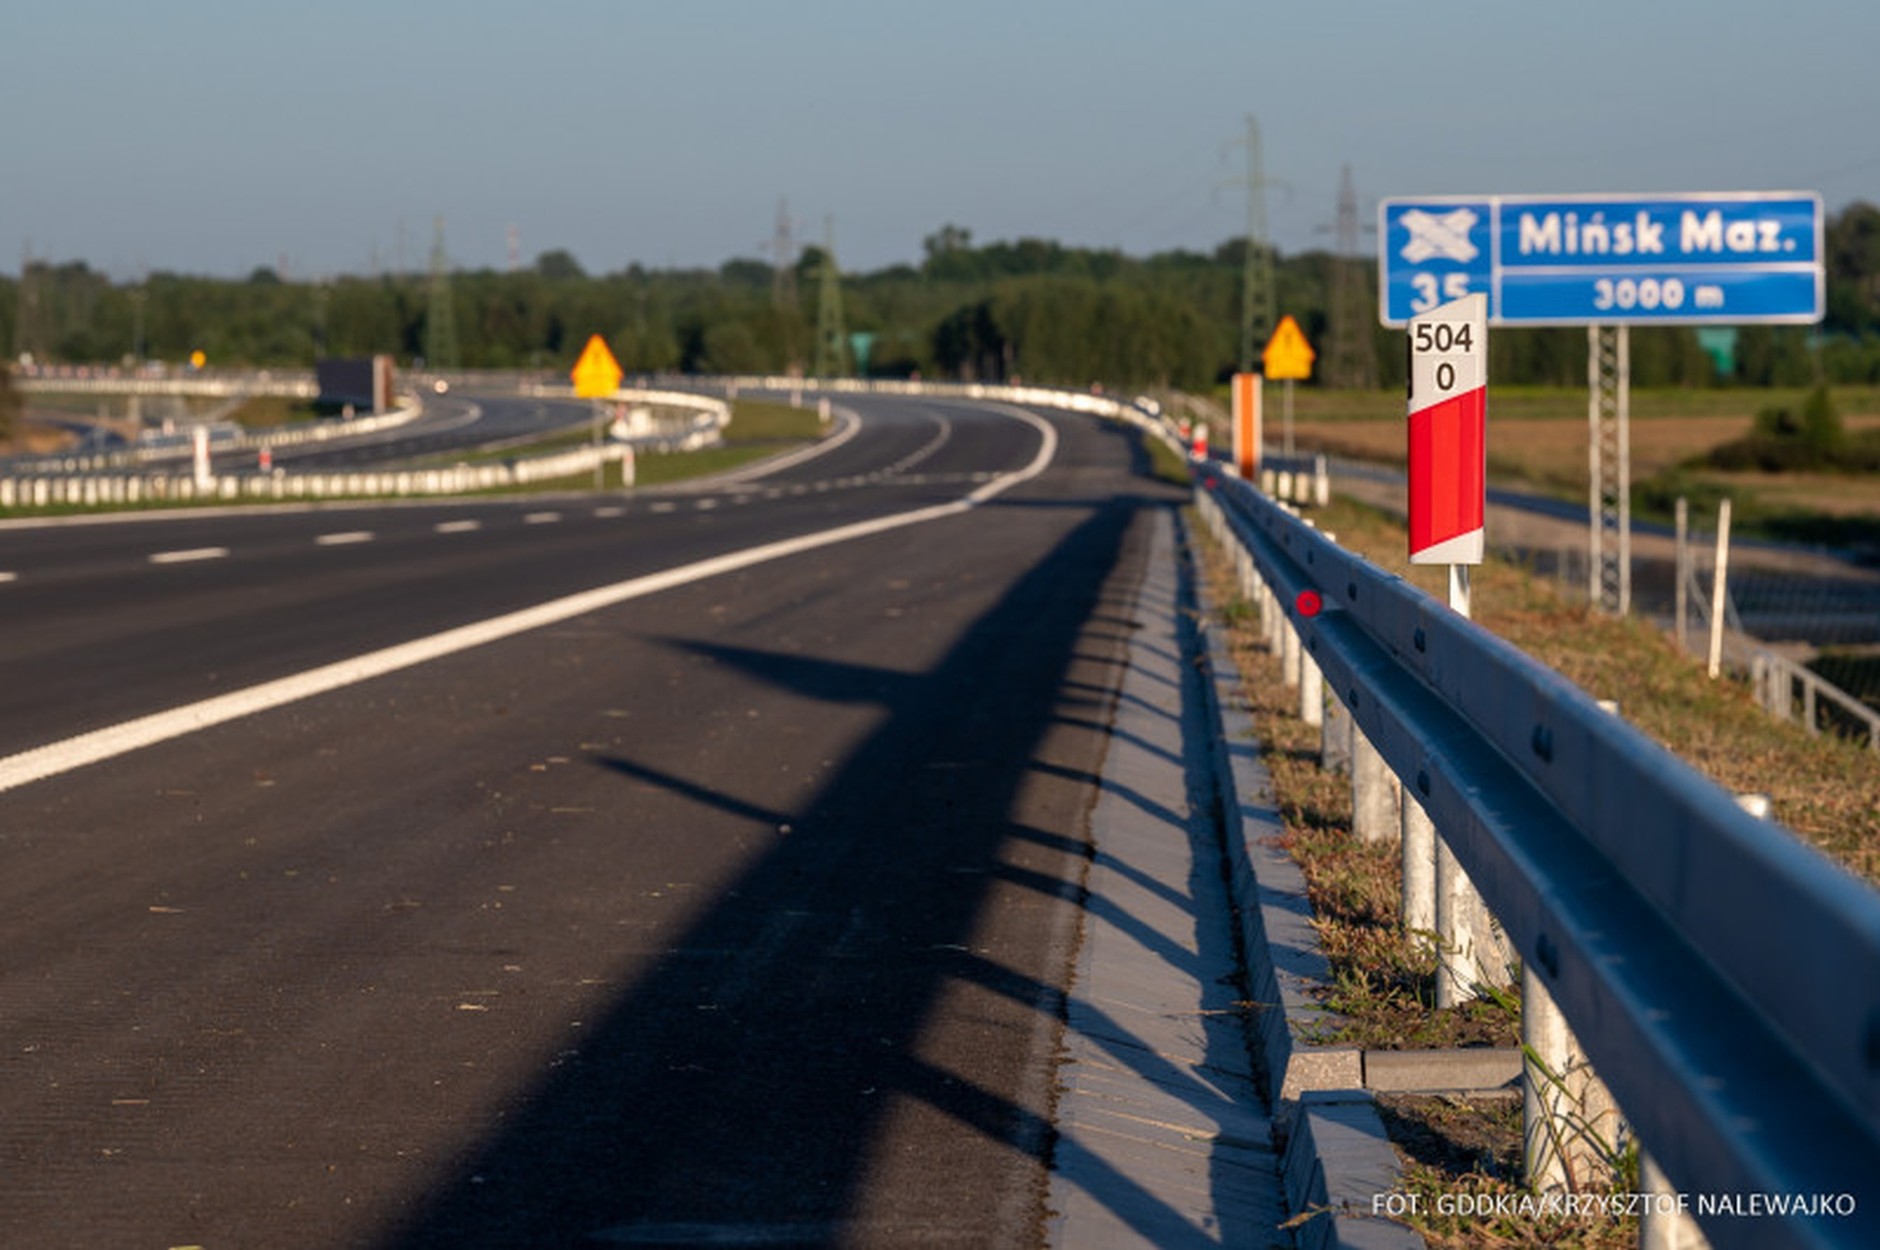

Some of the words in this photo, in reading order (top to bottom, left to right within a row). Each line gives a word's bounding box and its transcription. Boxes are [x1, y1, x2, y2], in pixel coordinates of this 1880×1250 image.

[1519, 211, 1665, 255] Mińsk
[1680, 209, 1797, 254] Maz.
[1593, 278, 1686, 310] 3000
[1694, 285, 1725, 308] m
[1415, 323, 1473, 352] 504
[1436, 362, 1455, 391] 0
